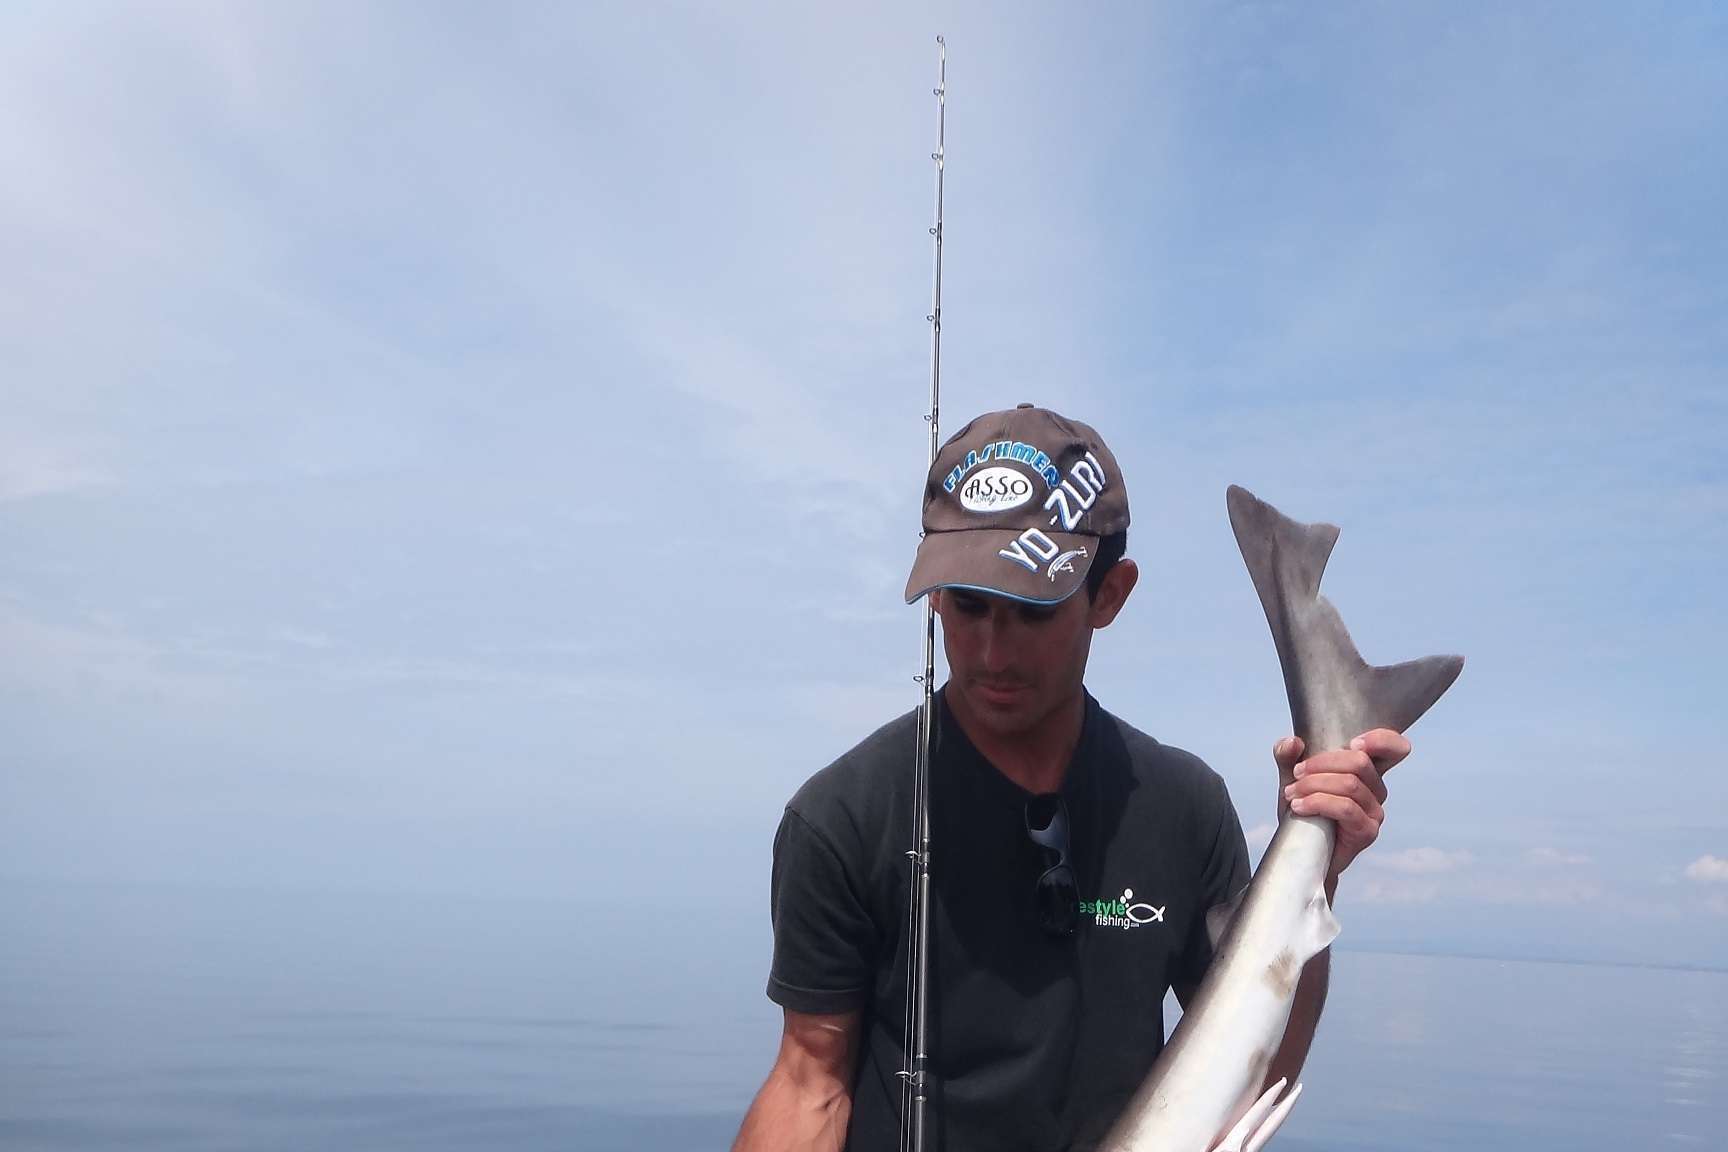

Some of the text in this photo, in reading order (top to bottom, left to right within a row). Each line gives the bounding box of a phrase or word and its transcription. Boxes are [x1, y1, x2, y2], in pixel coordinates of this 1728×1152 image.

[943, 441, 1060, 493] FLASHMER
[965, 475, 1029, 499] ASSO
[1080, 899, 1126, 916] estyle
